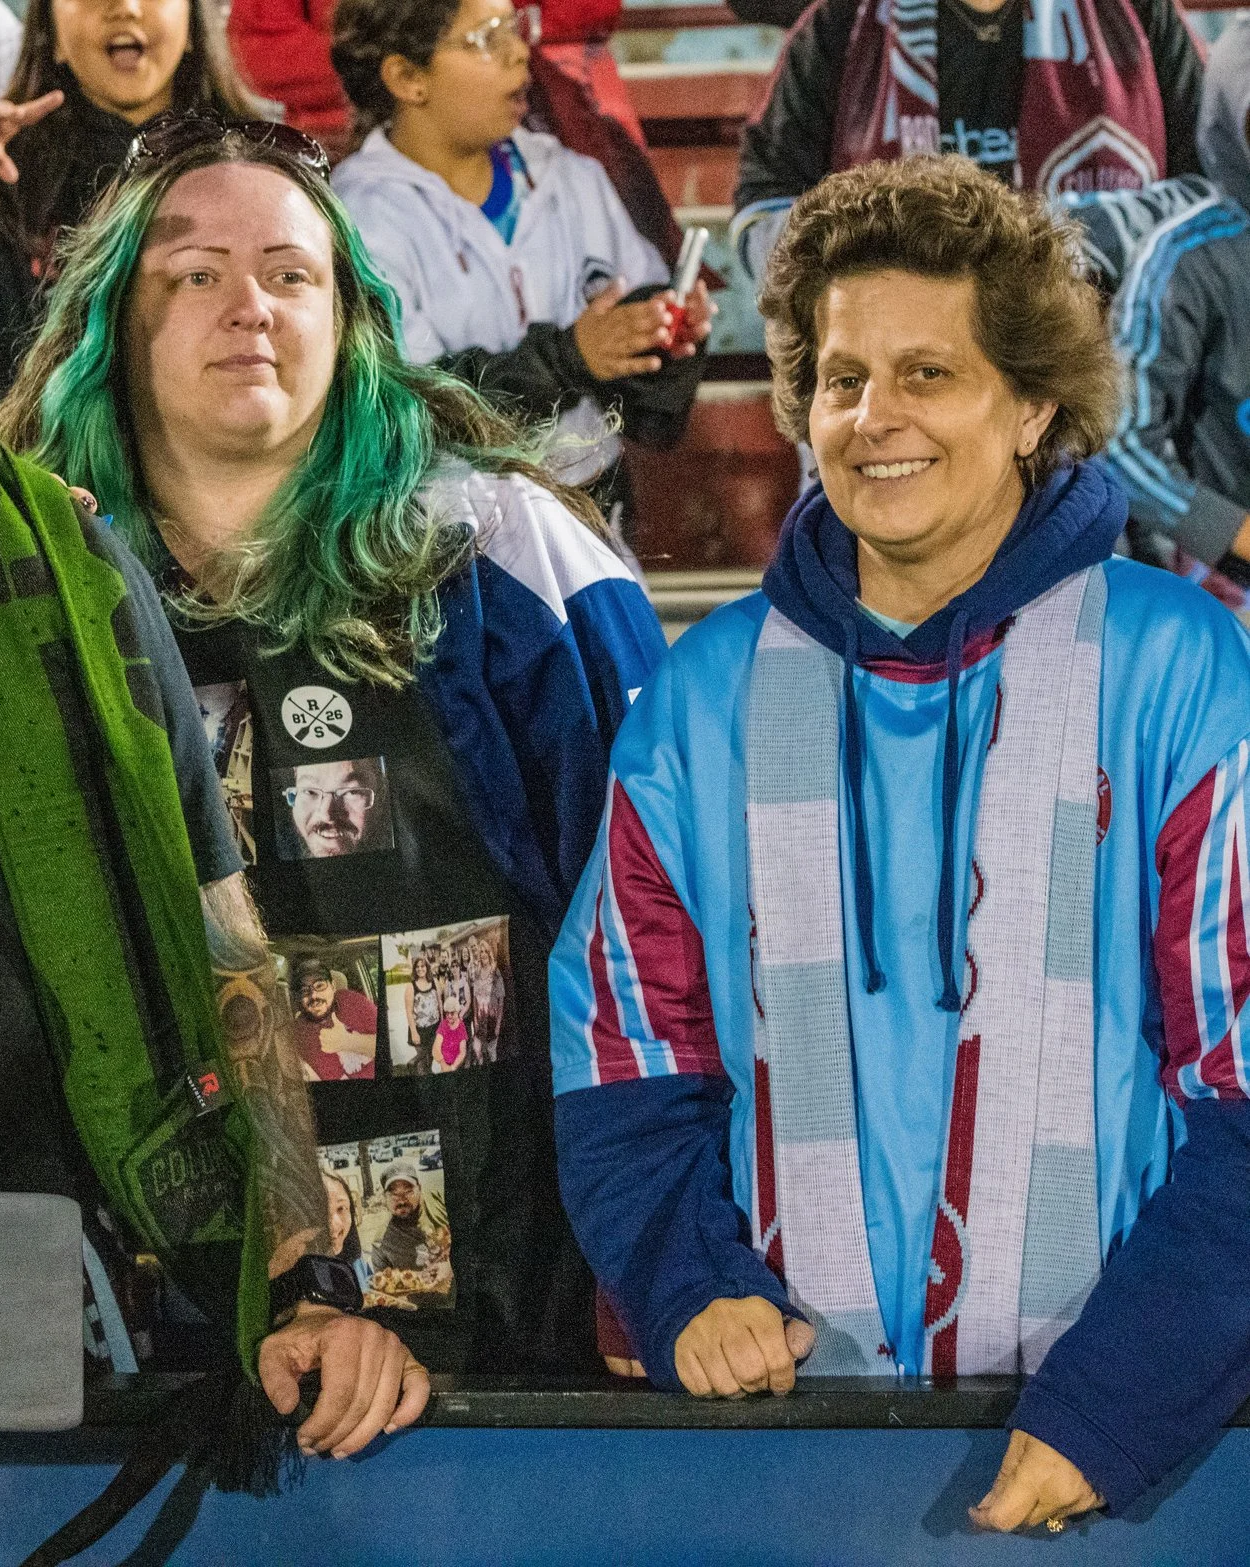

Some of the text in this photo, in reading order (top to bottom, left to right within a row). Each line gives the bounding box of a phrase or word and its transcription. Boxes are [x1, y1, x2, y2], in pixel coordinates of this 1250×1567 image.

[306, 699, 320, 711] R
[292, 713, 307, 724] 81
[325, 709, 343, 721] 26
[313, 726, 325, 738] S
